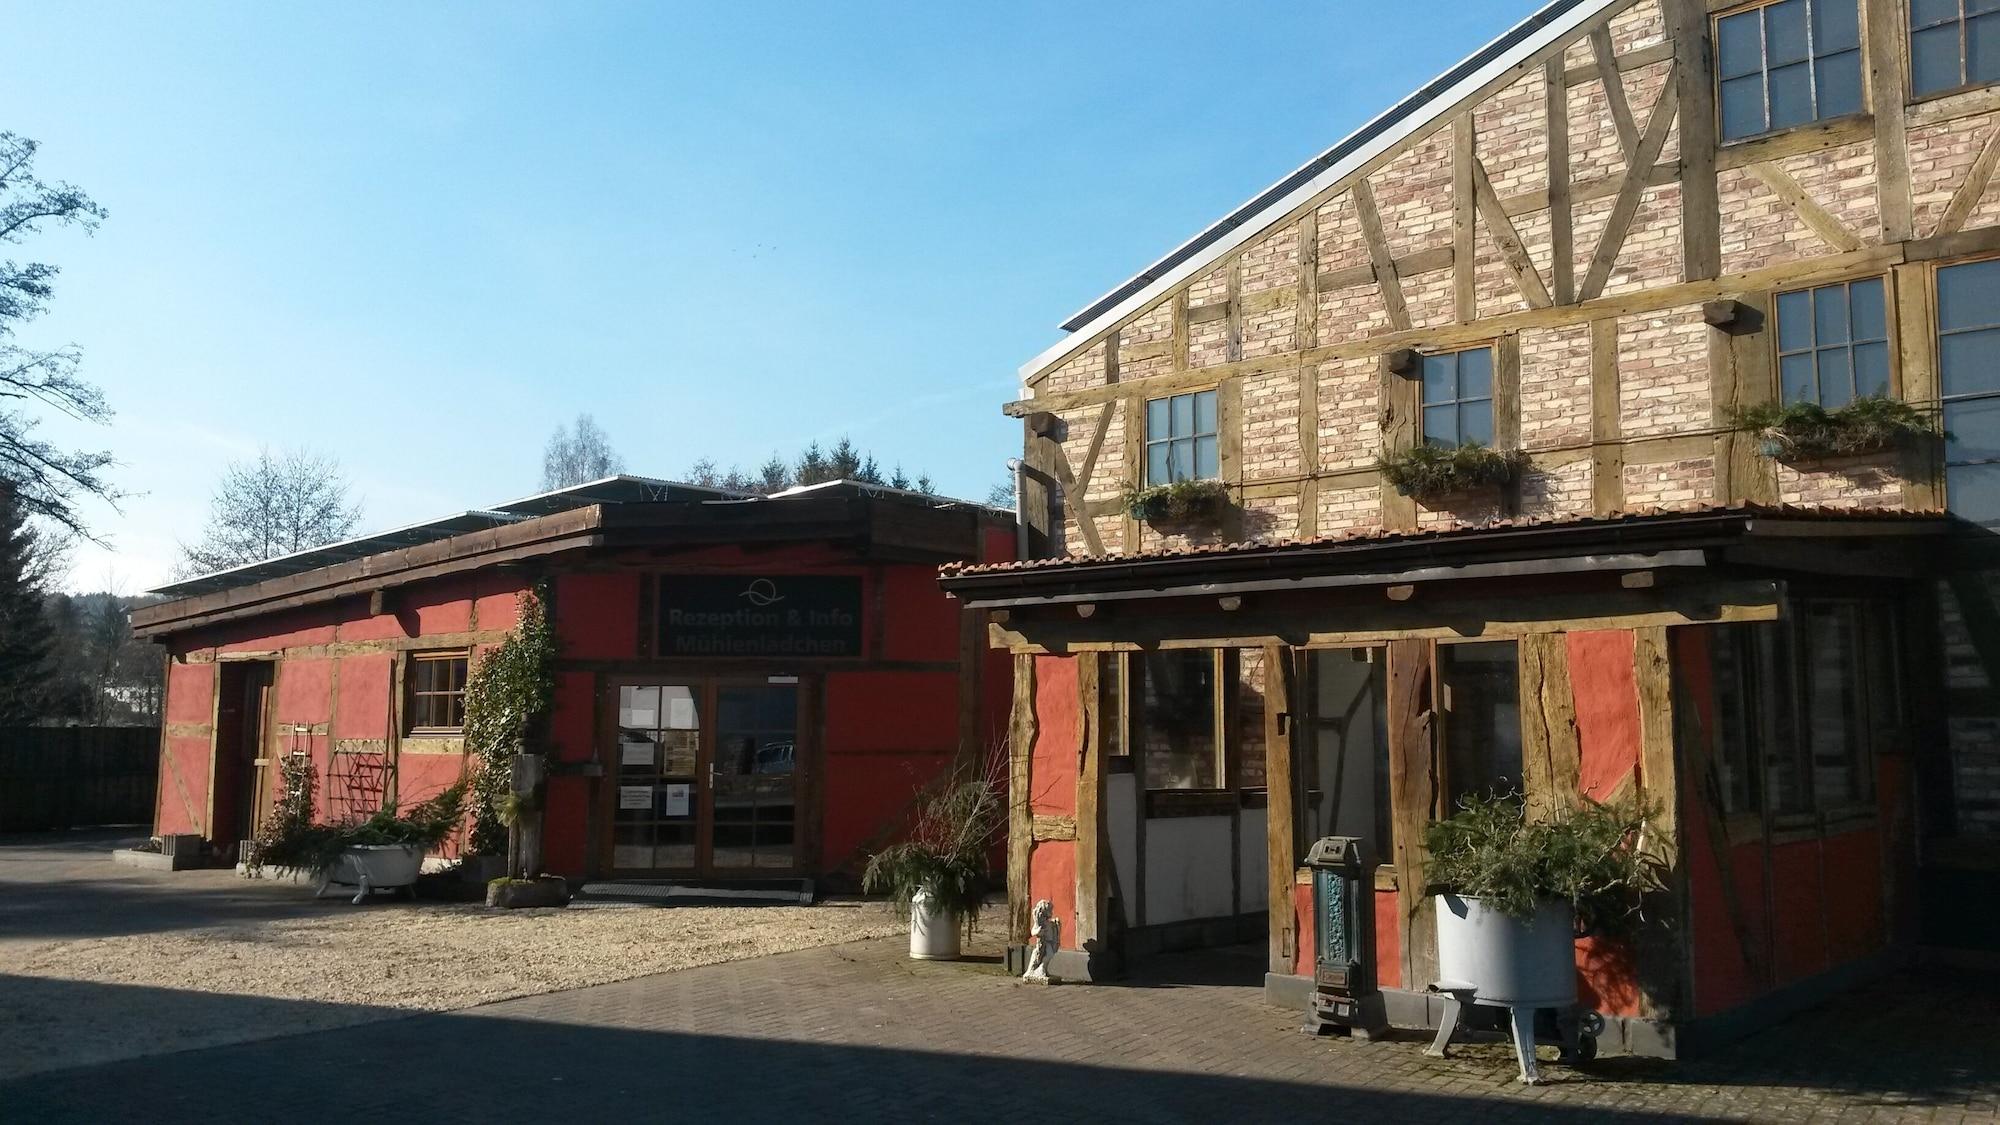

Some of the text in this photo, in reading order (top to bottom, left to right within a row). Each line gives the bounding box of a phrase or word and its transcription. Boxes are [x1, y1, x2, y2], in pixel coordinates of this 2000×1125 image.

[669, 608, 853, 630] Rezeption & Info
